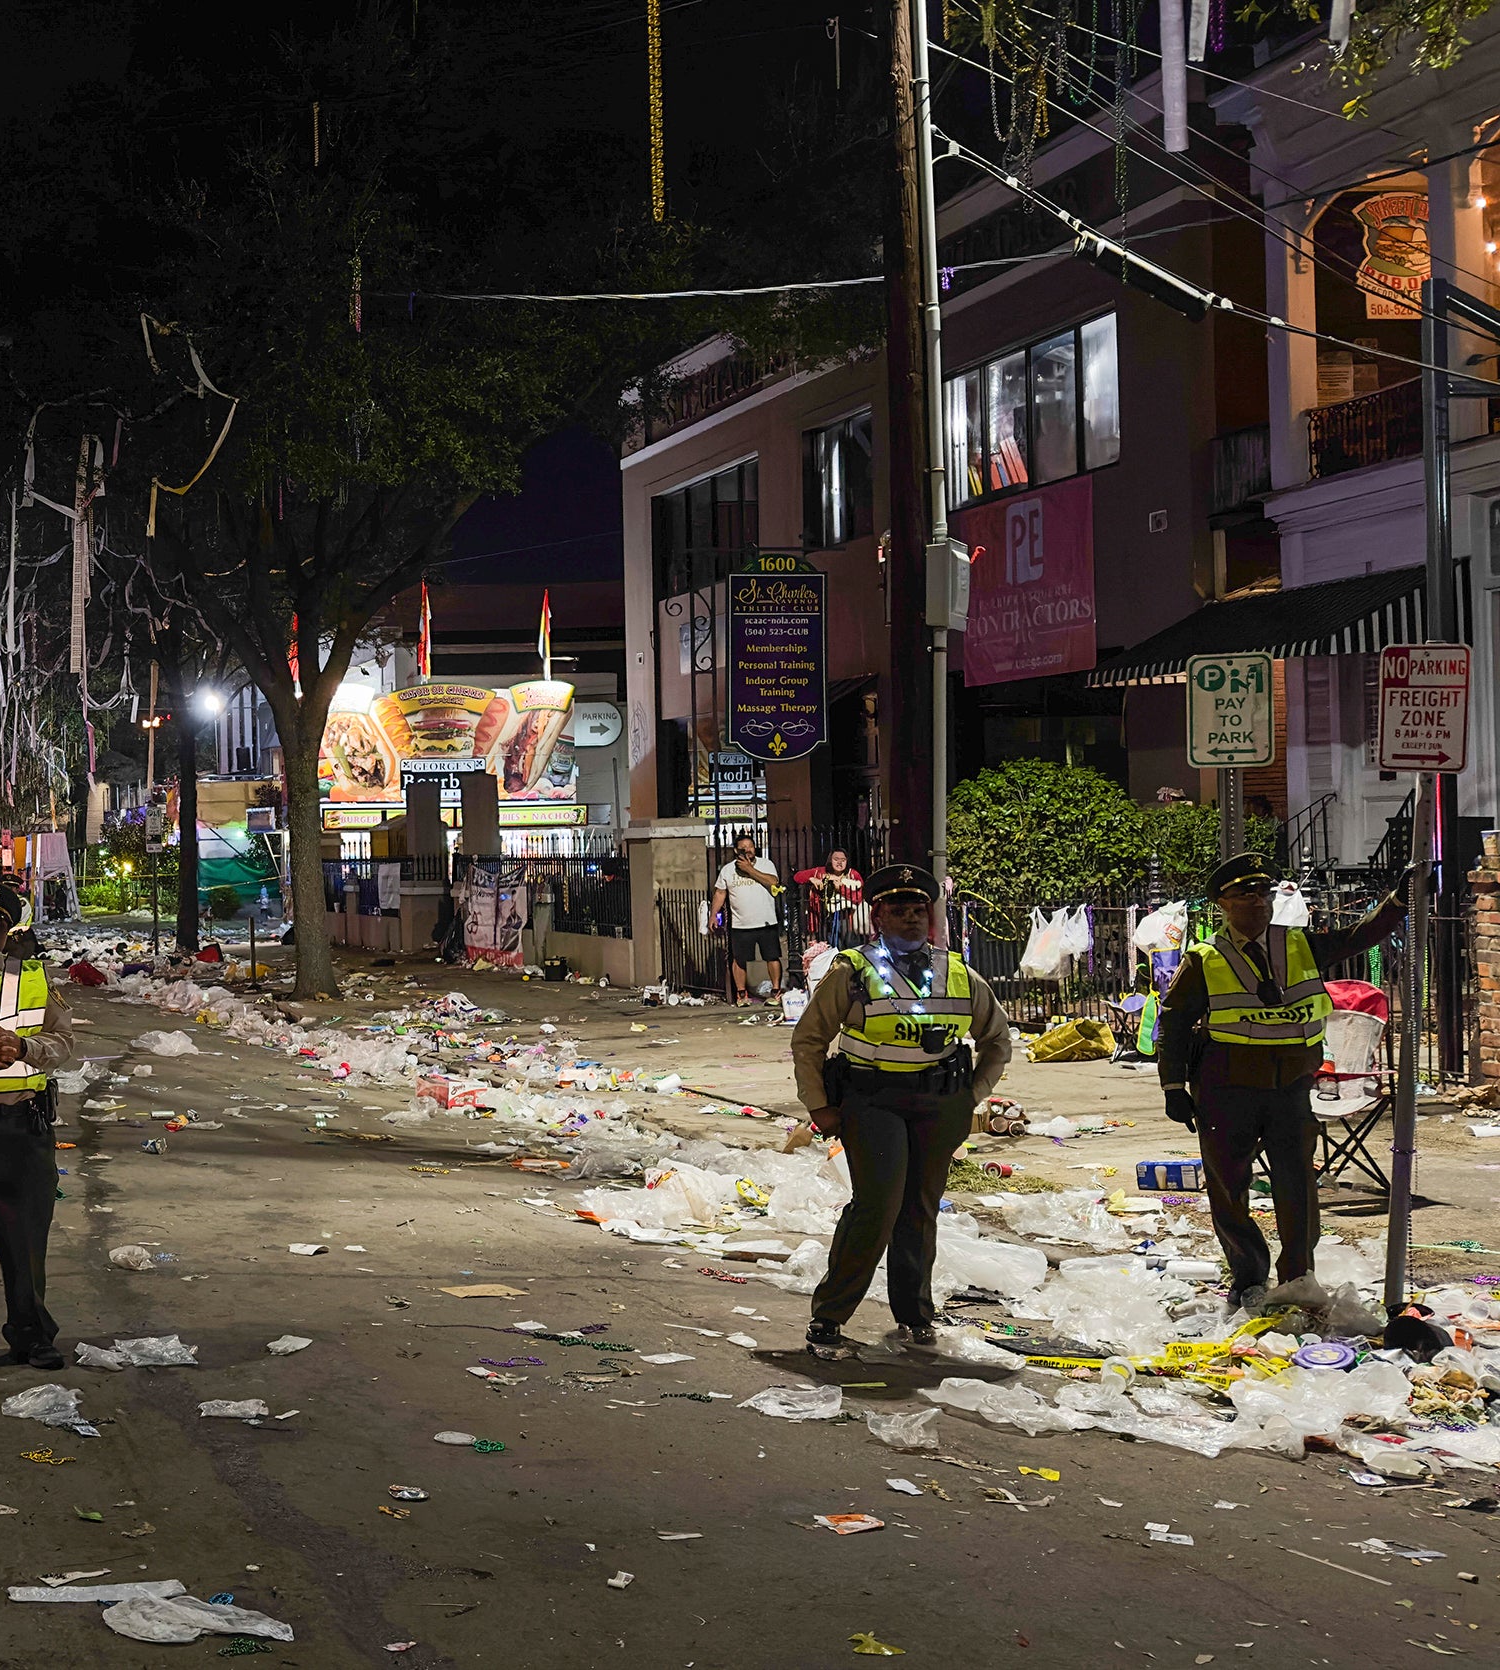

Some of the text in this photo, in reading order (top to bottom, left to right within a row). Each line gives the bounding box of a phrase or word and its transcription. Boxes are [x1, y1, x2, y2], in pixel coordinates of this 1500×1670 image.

[1012, 509, 1044, 585] PE
[758, 557, 796, 571] 1600
[766, 580, 818, 604] Charles
[744, 617, 809, 625] scaac-nola.com
[967, 595, 1092, 639] CONTRACTORS
[744, 628, 809, 636] (504) 523-CLUB
[746, 644, 808, 653] Memberships
[738, 661, 815, 671] Personal Training
[1383, 656, 1466, 679] NO PARKING
[745, 676, 809, 687] Indoor Group
[759, 688, 795, 698] Training
[1389, 691, 1461, 707] FREIGHT
[737, 703, 818, 714] Massage Therapy
[1214, 697, 1246, 710] PAY
[1219, 714, 1242, 727] TO
[1401, 710, 1446, 727] ZONE
[1208, 731, 1254, 744] PARK
[1395, 729, 1401, 739] 8
[1403, 730, 1418, 738] AM
[1425, 730, 1432, 739] 6
[1435, 730, 1451, 739] PM
[413, 762, 473, 770] GEORGE'S
[500, 812, 577, 821] RIES NACHOS
